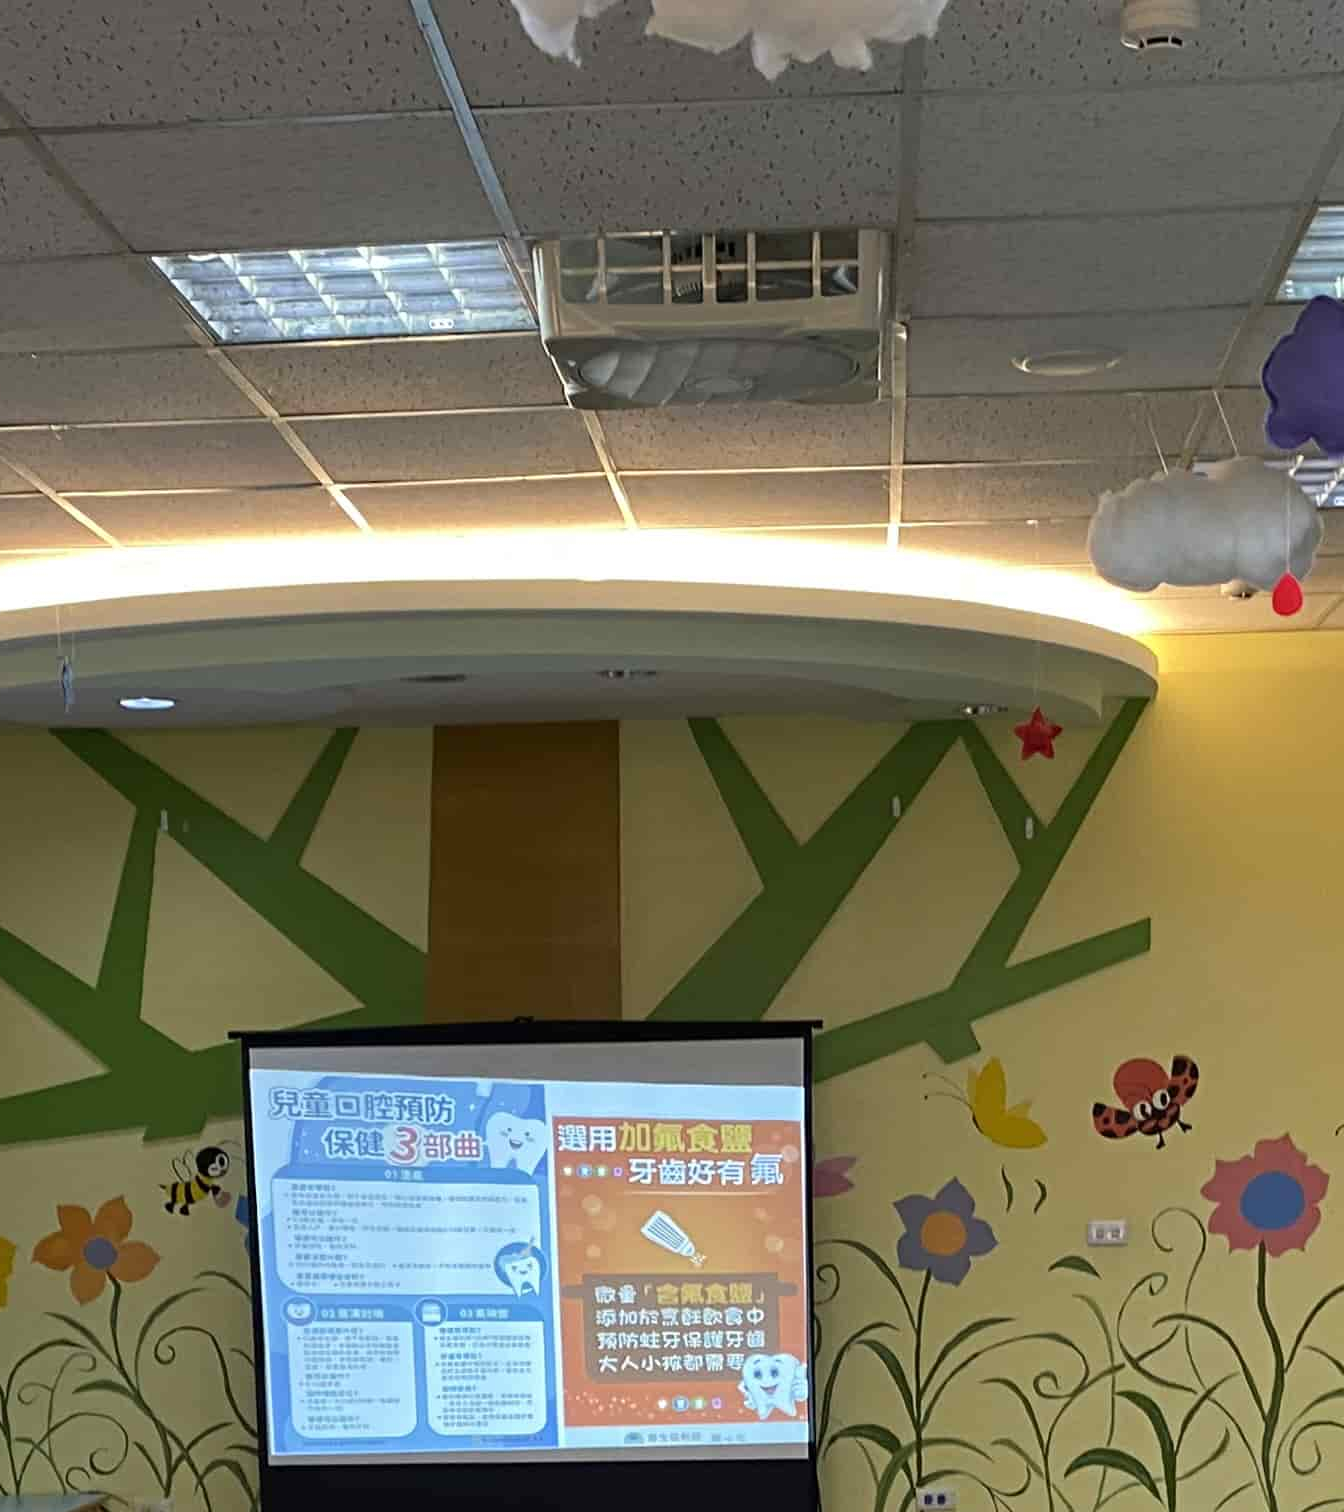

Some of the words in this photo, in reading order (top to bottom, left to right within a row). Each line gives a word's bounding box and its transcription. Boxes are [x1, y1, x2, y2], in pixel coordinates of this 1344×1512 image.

[270, 1088, 455, 1124] 兒童口腔預防
[324, 1125, 482, 1164] 保健3部曲
[557, 1120, 753, 1153] 選用加氟食鹽
[628, 1153, 784, 1185] 牙齒好有氟
